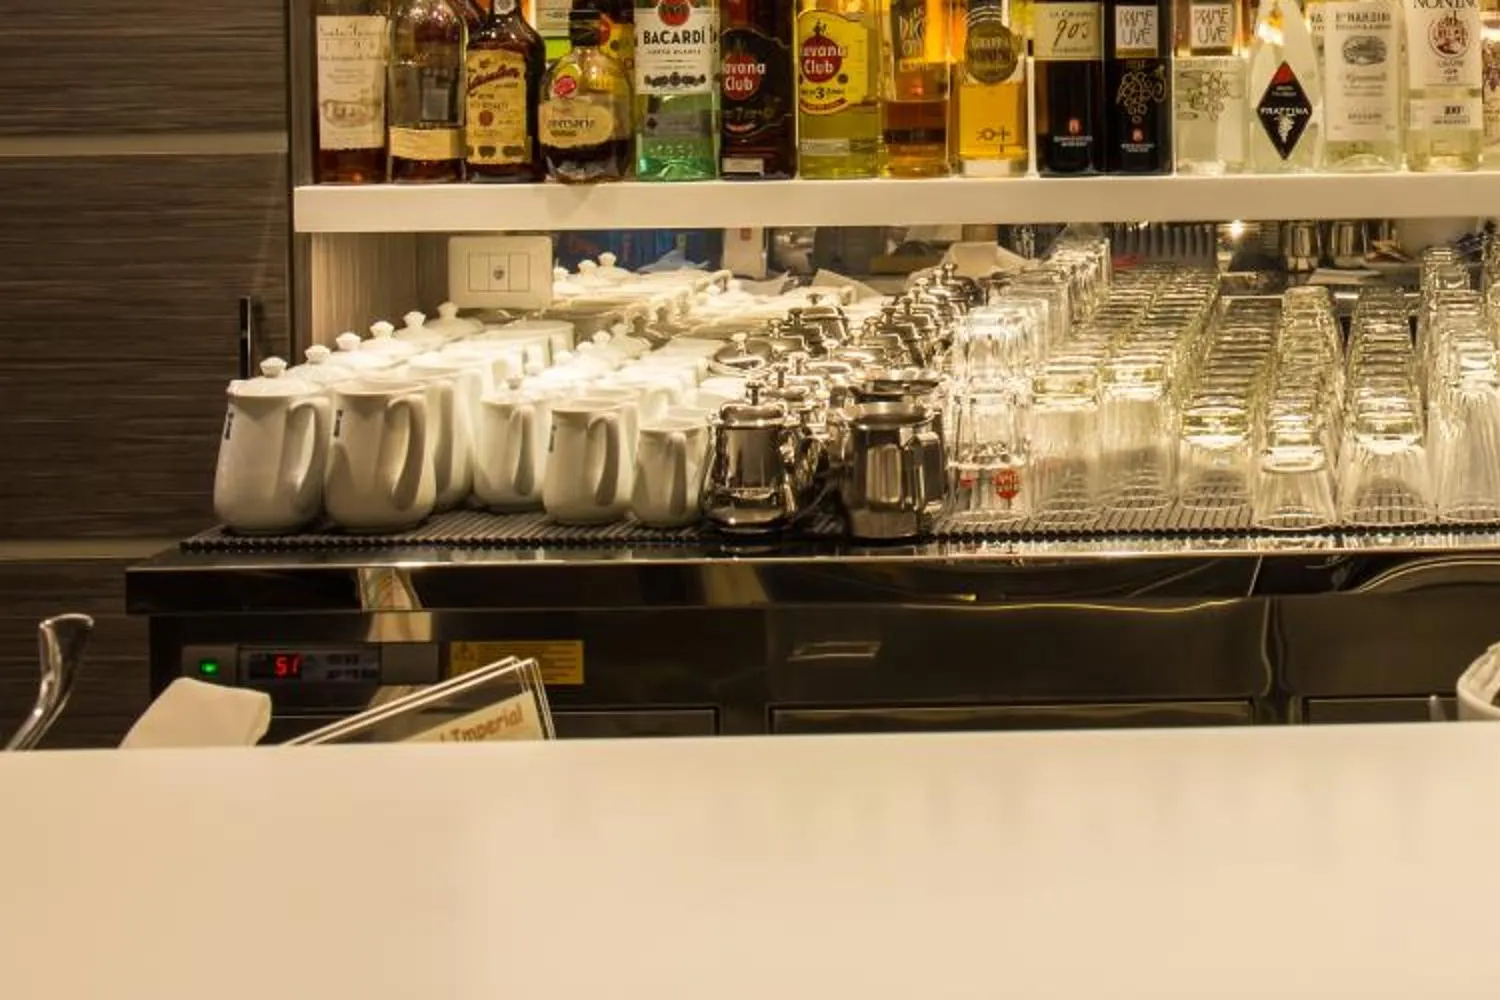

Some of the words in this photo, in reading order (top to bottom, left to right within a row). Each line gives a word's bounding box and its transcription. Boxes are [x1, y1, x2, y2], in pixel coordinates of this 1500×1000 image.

[643, 26, 705, 45] BACARDÍ
[722, 63, 766, 75] avana
[803, 58, 835, 75] Club
[724, 75, 754, 91] Club
[815, 87, 825, 100] 3
